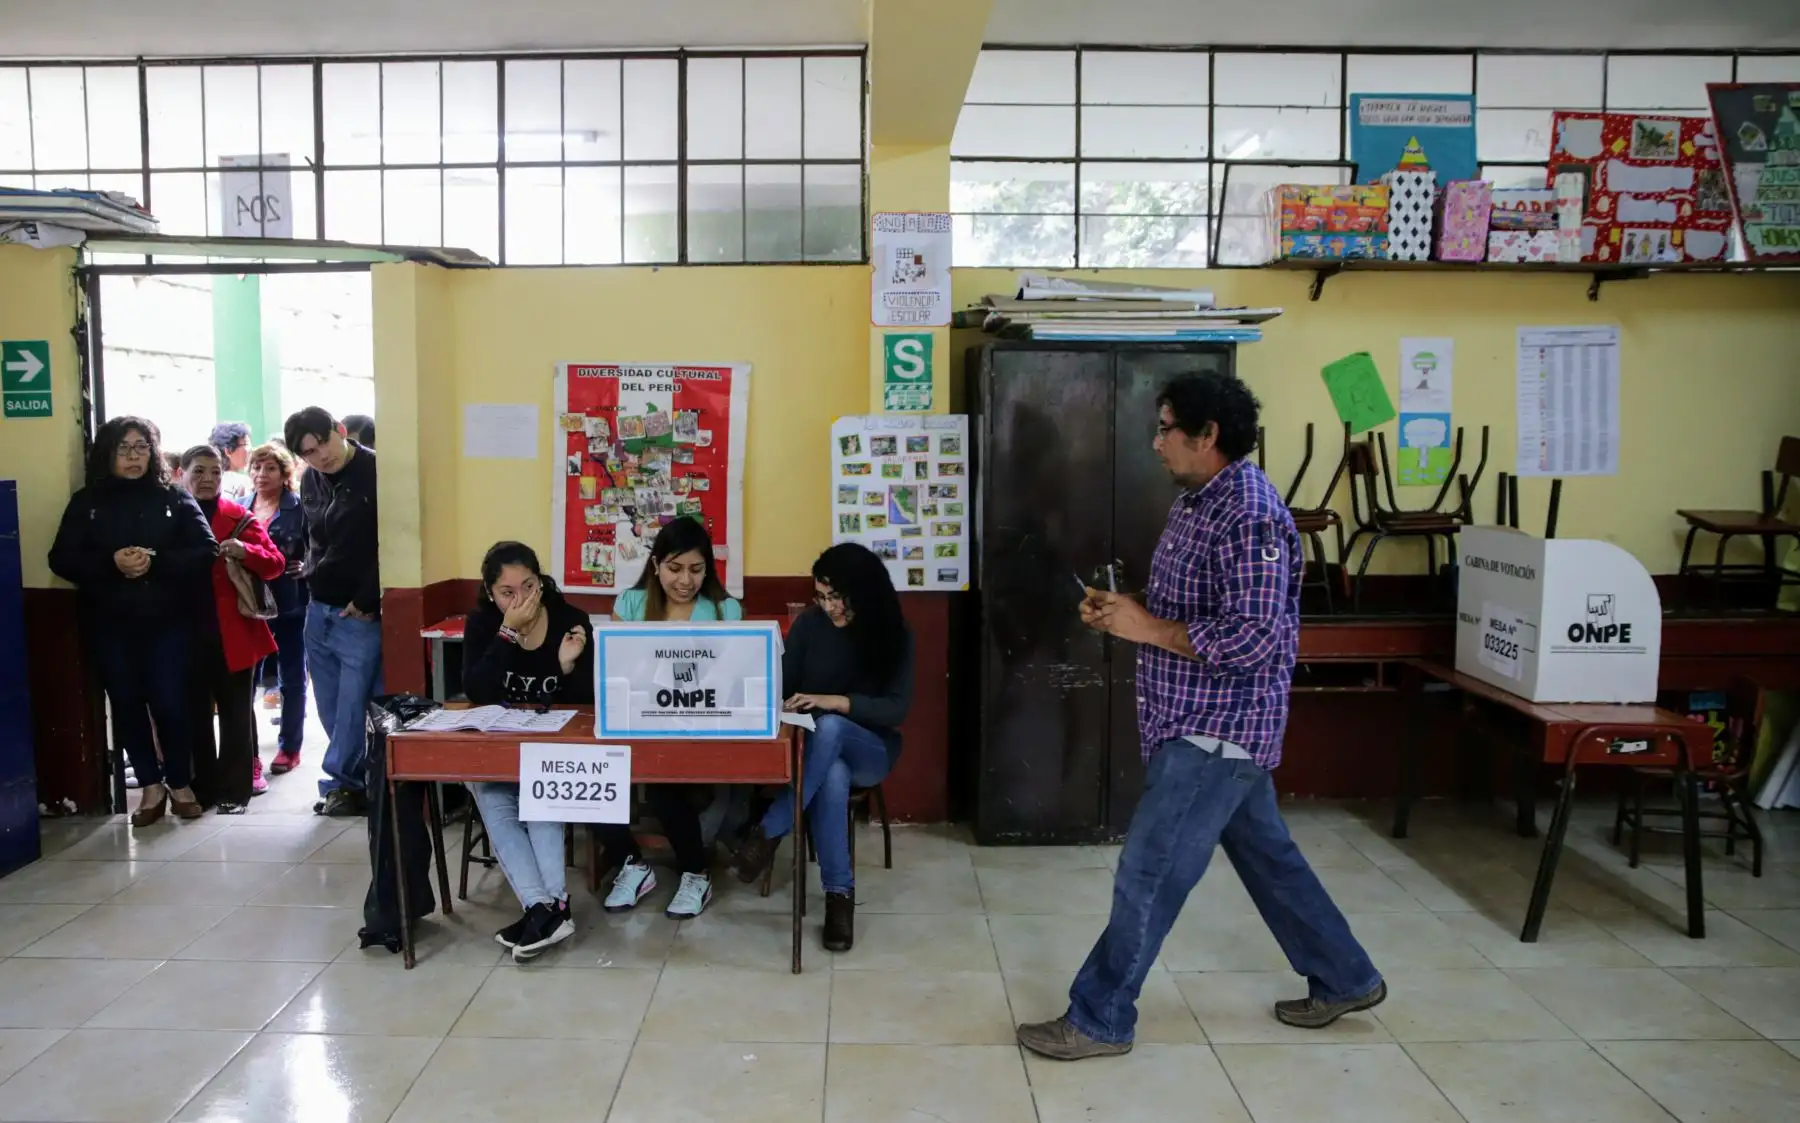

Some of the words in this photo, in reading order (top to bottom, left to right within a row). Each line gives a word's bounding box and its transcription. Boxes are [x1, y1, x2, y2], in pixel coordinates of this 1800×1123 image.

[892, 338, 925, 379] S
[578, 367, 652, 378] DIVERSIDAD
[656, 369, 721, 380] CULTURAL
[621, 383, 645, 392] DEL
[6, 399, 49, 411] SALIDA
[1465, 554, 1490, 571] CABINA
[1490, 559, 1500, 573] DE
[1500, 561, 1536, 580] VOTACIÓN
[1489, 618, 1508, 634] MESA
[1567, 622, 1632, 644] ONPE
[655, 649, 716, 660] MUNICIPAL
[1484, 632, 1519, 661] 033225
[656, 688, 716, 708] ONPE
[541, 760, 587, 775] MESA
[532, 780, 617, 802] 033225
